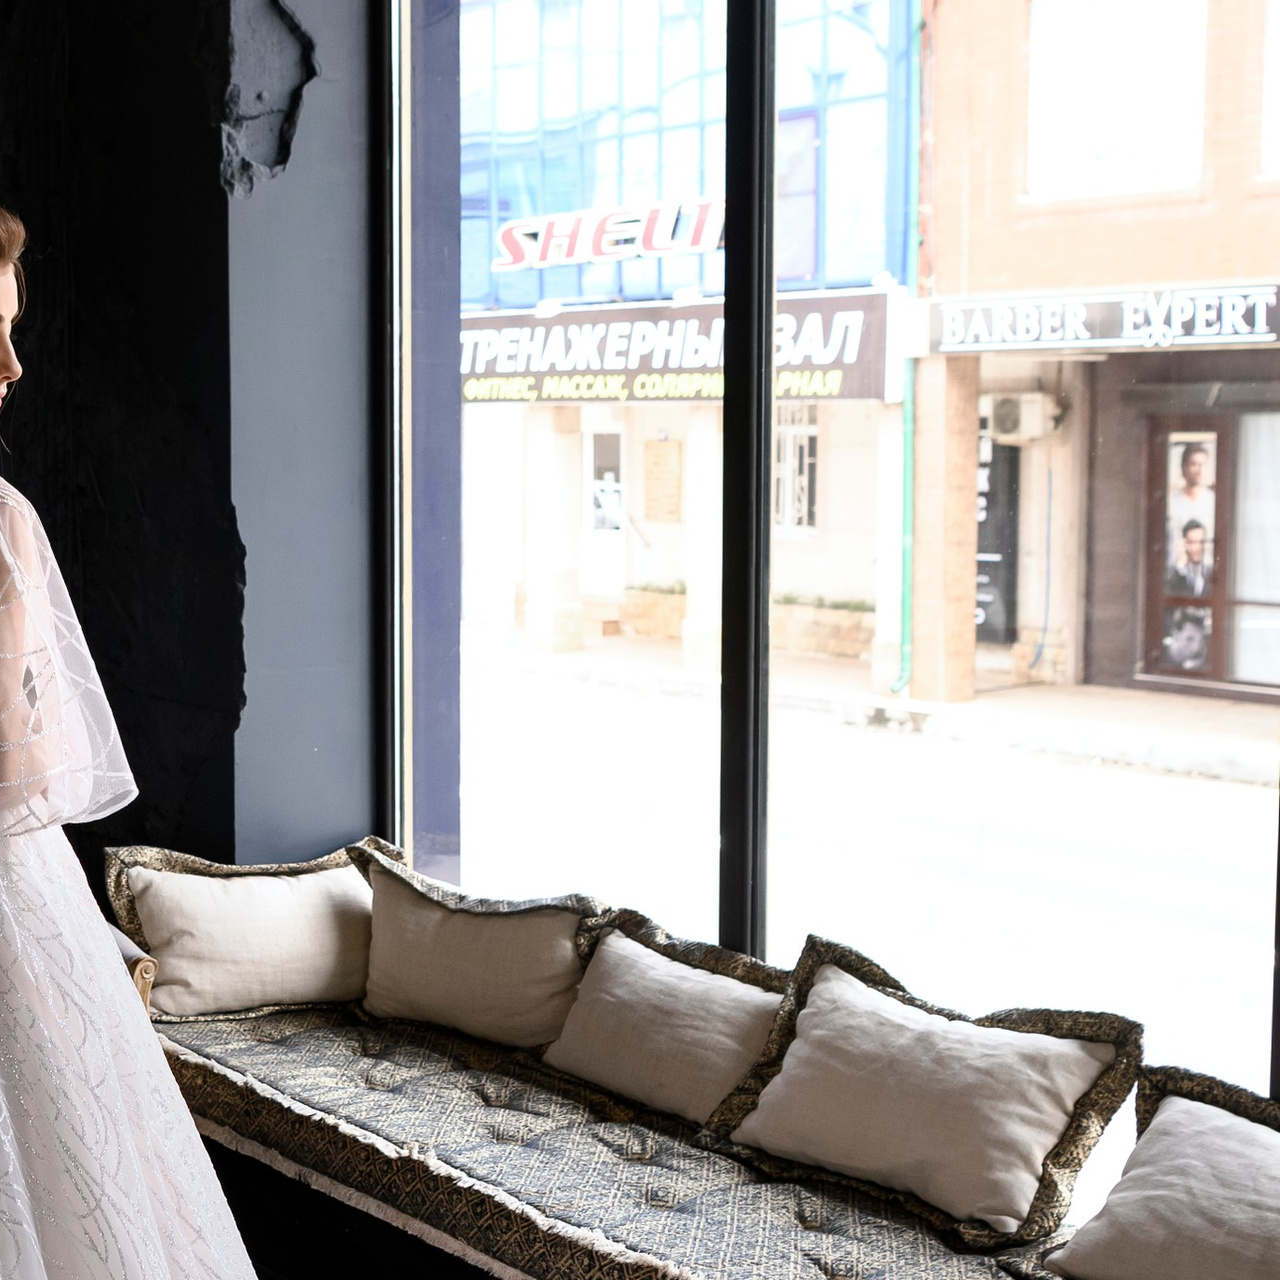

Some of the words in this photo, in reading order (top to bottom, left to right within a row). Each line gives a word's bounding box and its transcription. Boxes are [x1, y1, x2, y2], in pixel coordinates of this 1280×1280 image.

[460, 318, 724, 375] ТРЕНАЖЕРНЫ
[776, 310, 865, 367] ЗАЛ
[941, 302, 1091, 345] BARBER
[542, 374, 628, 401] МАССАЖ,
[776, 370, 843, 397] РНАЯ
